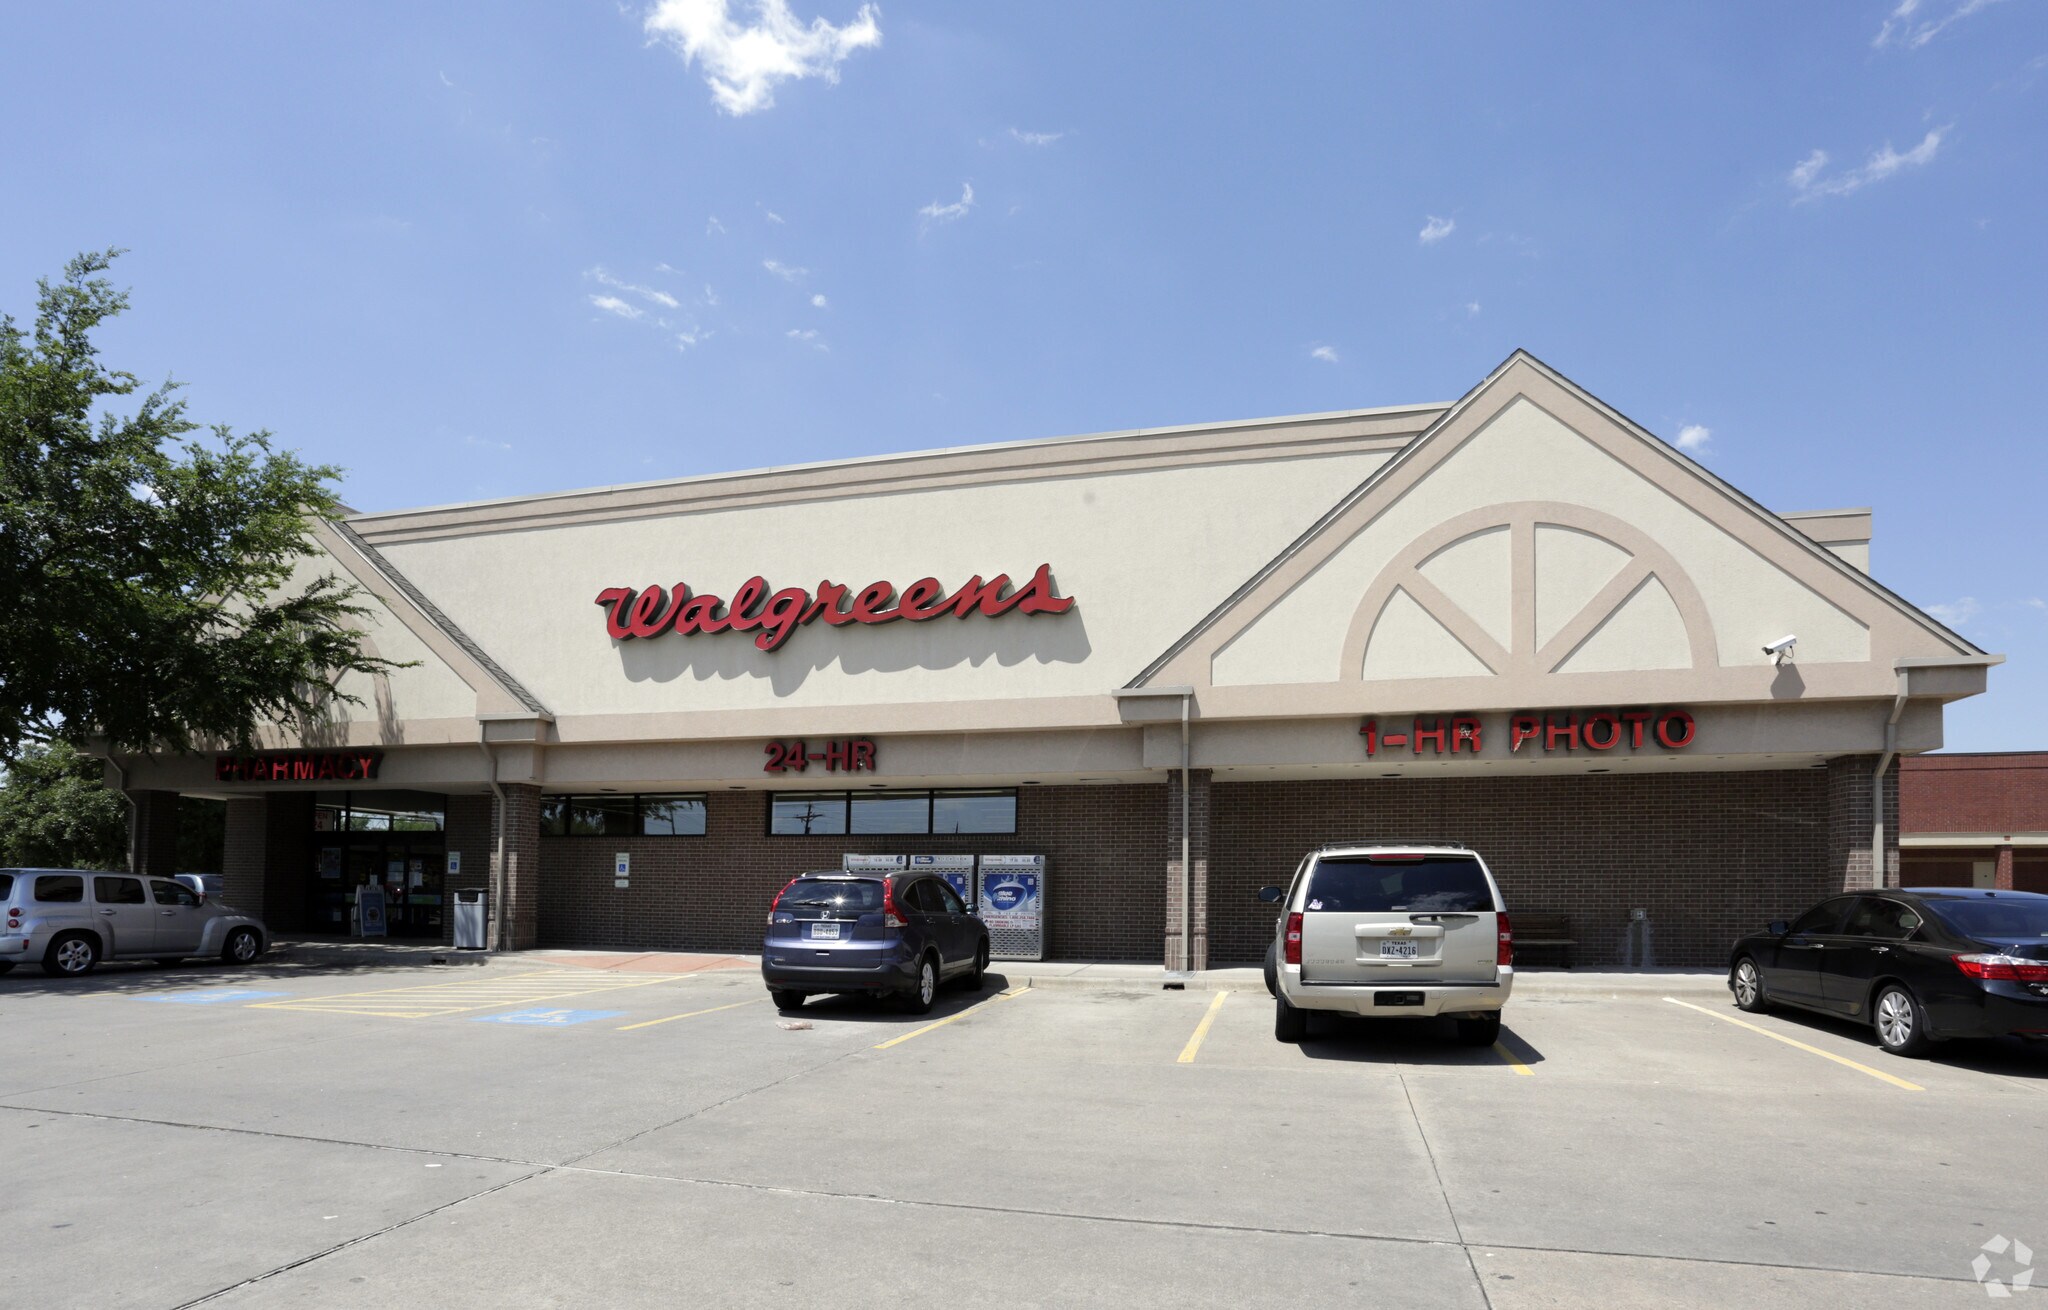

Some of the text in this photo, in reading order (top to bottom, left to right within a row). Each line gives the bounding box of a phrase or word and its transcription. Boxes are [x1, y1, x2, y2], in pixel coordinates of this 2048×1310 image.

[596, 563, 1075, 652] Walgreens
[1360, 710, 1697, 755] 1-HR PHOTO
[763, 740, 877, 773] 24-HR
